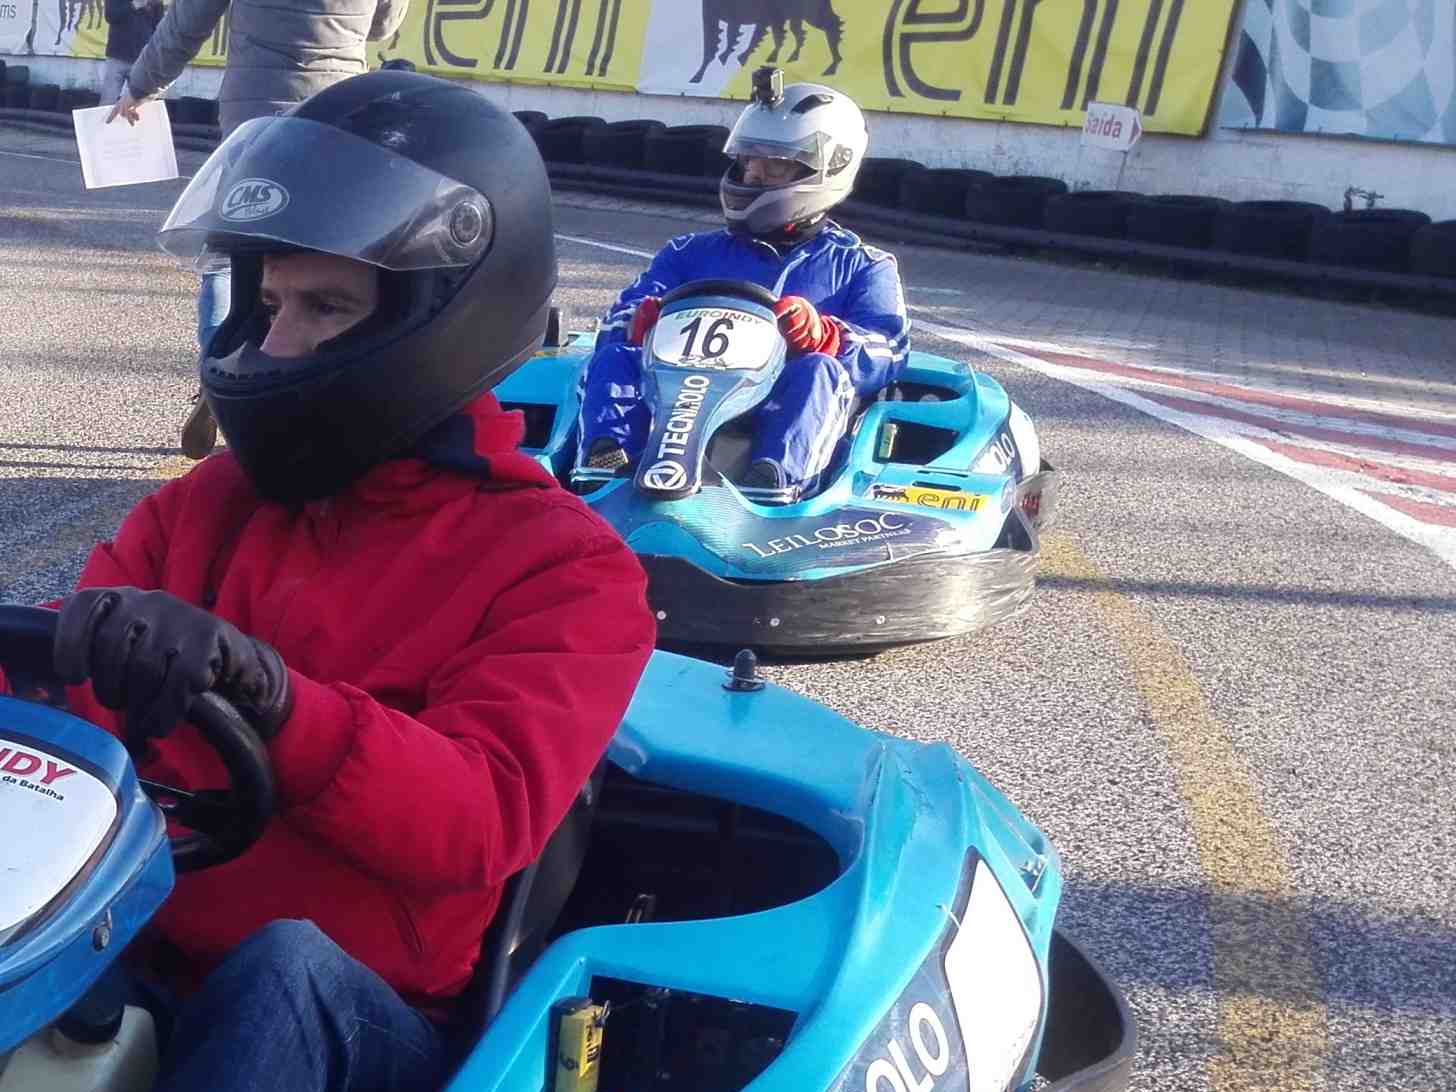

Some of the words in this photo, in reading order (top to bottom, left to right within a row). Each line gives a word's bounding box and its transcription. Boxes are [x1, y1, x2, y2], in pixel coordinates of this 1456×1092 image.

[228, 184, 272, 206] CMS
[679, 317, 735, 359] 16
[742, 512, 904, 558] LEILOSOC
[818, 538, 862, 550] MARKET
[2, 775, 17, 785] da
[19, 779, 65, 801] Batalha
